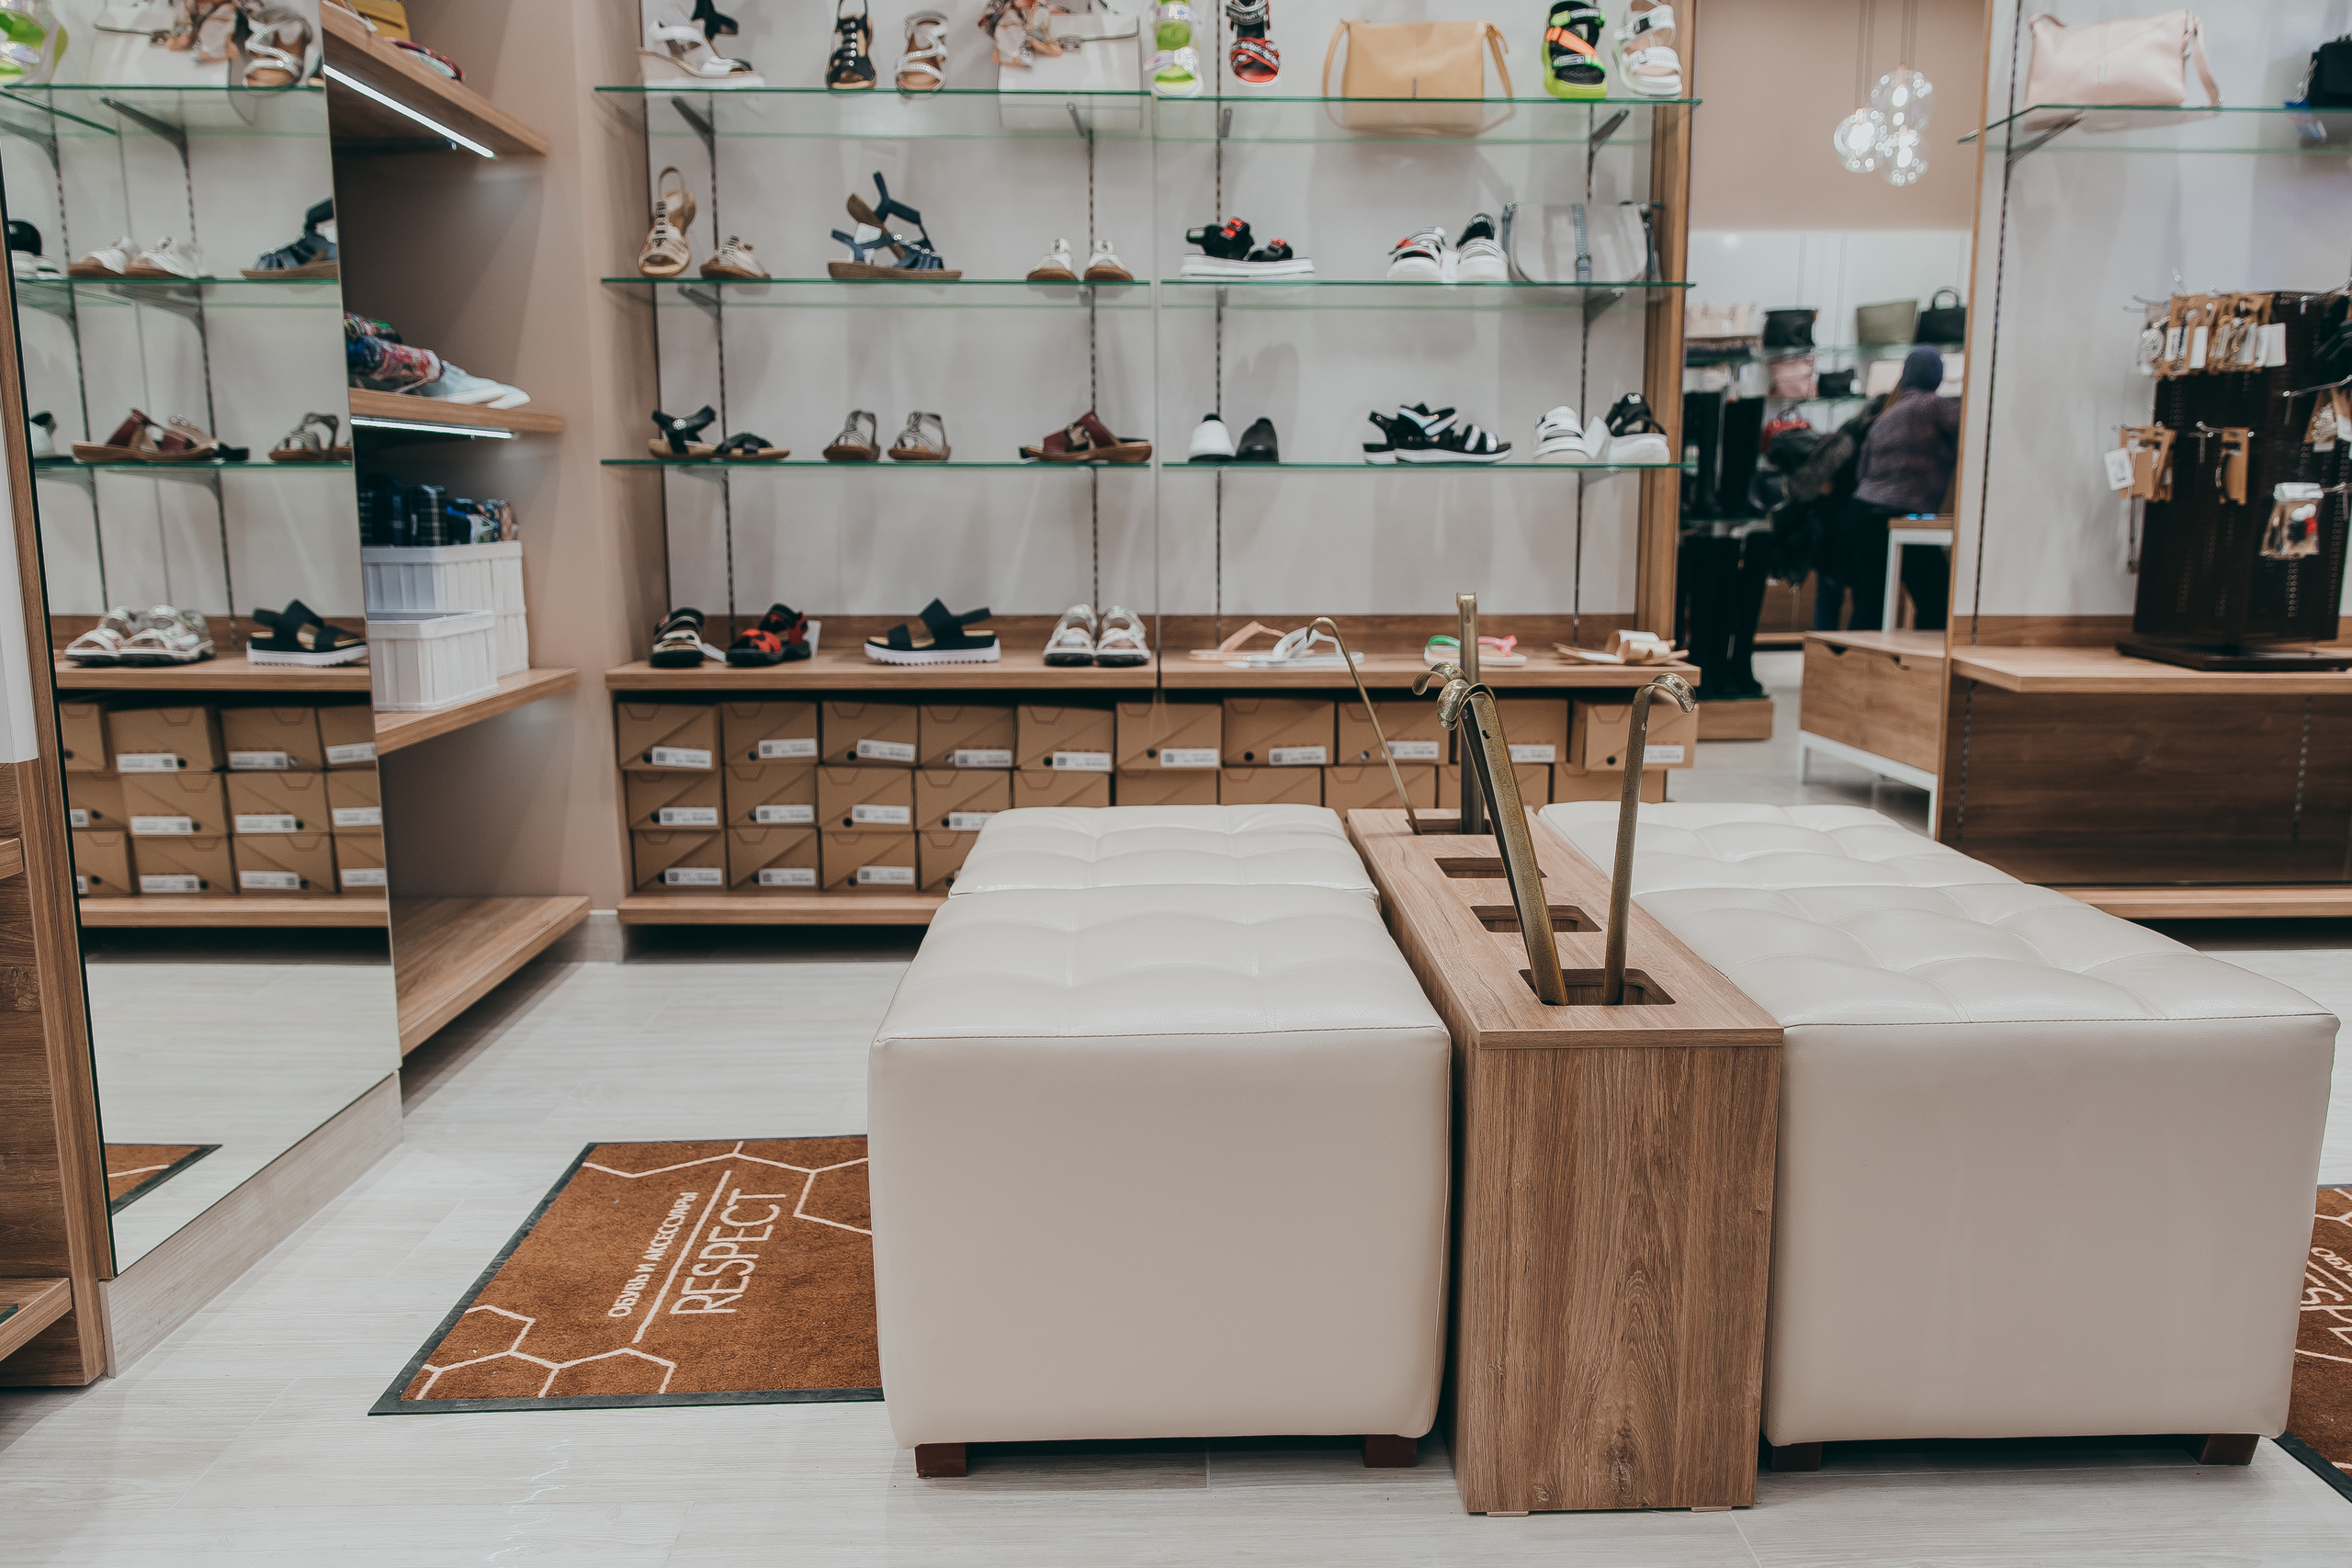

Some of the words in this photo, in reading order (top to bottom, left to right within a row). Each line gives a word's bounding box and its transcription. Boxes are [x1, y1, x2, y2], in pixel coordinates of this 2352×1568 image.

[642, 1191, 698, 1261] АКСЕССУАРЫ
[670, 1188, 786, 1314] RESPECT
[607, 1273, 650, 1317] ОБУВЬ
[634, 1263, 657, 1272] И
